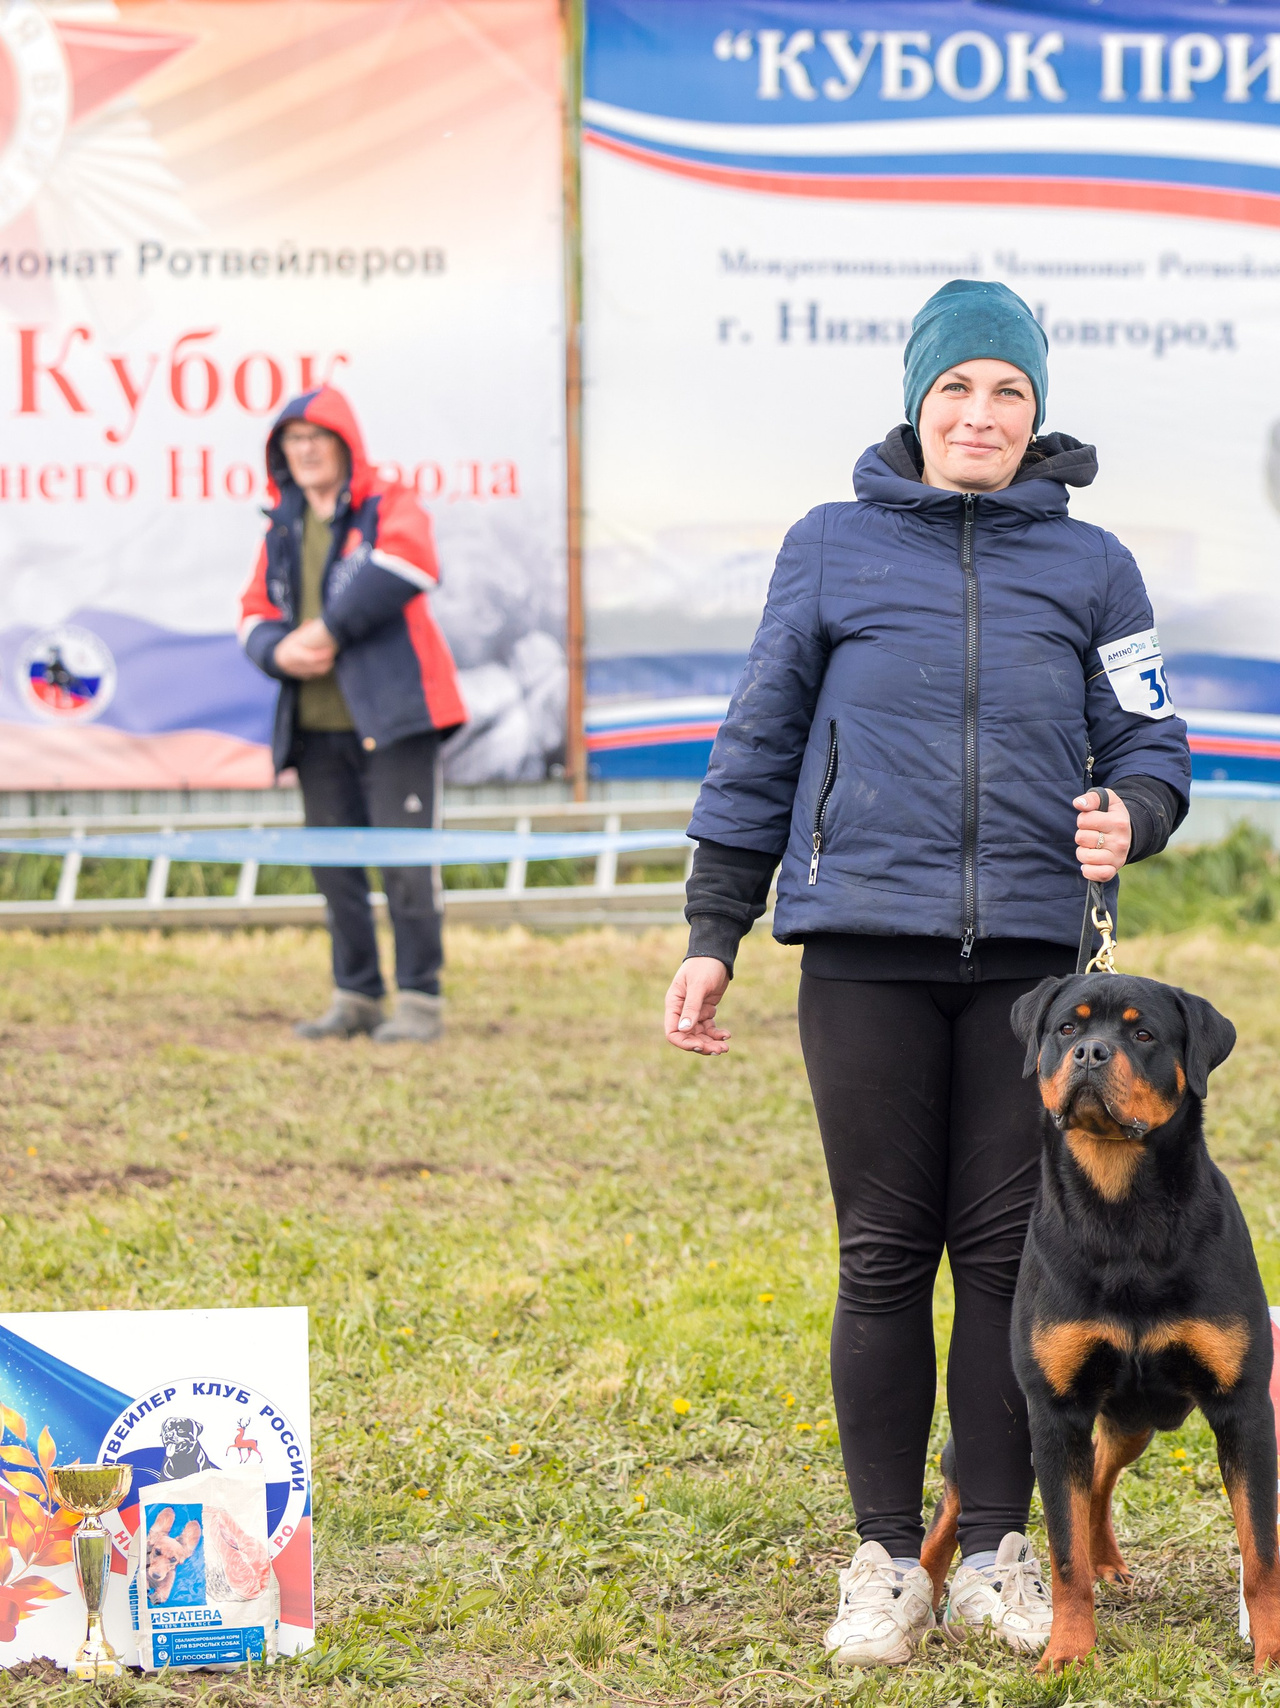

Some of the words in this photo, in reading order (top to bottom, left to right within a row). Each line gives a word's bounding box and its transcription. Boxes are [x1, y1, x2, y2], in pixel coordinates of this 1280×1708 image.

[138, 241, 446, 284] Ротвейлеров
[718, 317, 752, 343] г.
[192, 1382, 251, 1405] КЛУБ
[259, 1405, 305, 1492] РОССИИ
[161, 1609, 222, 1623] STATERA
[182, 1653, 216, 1661] ЛОСОСЕМ
